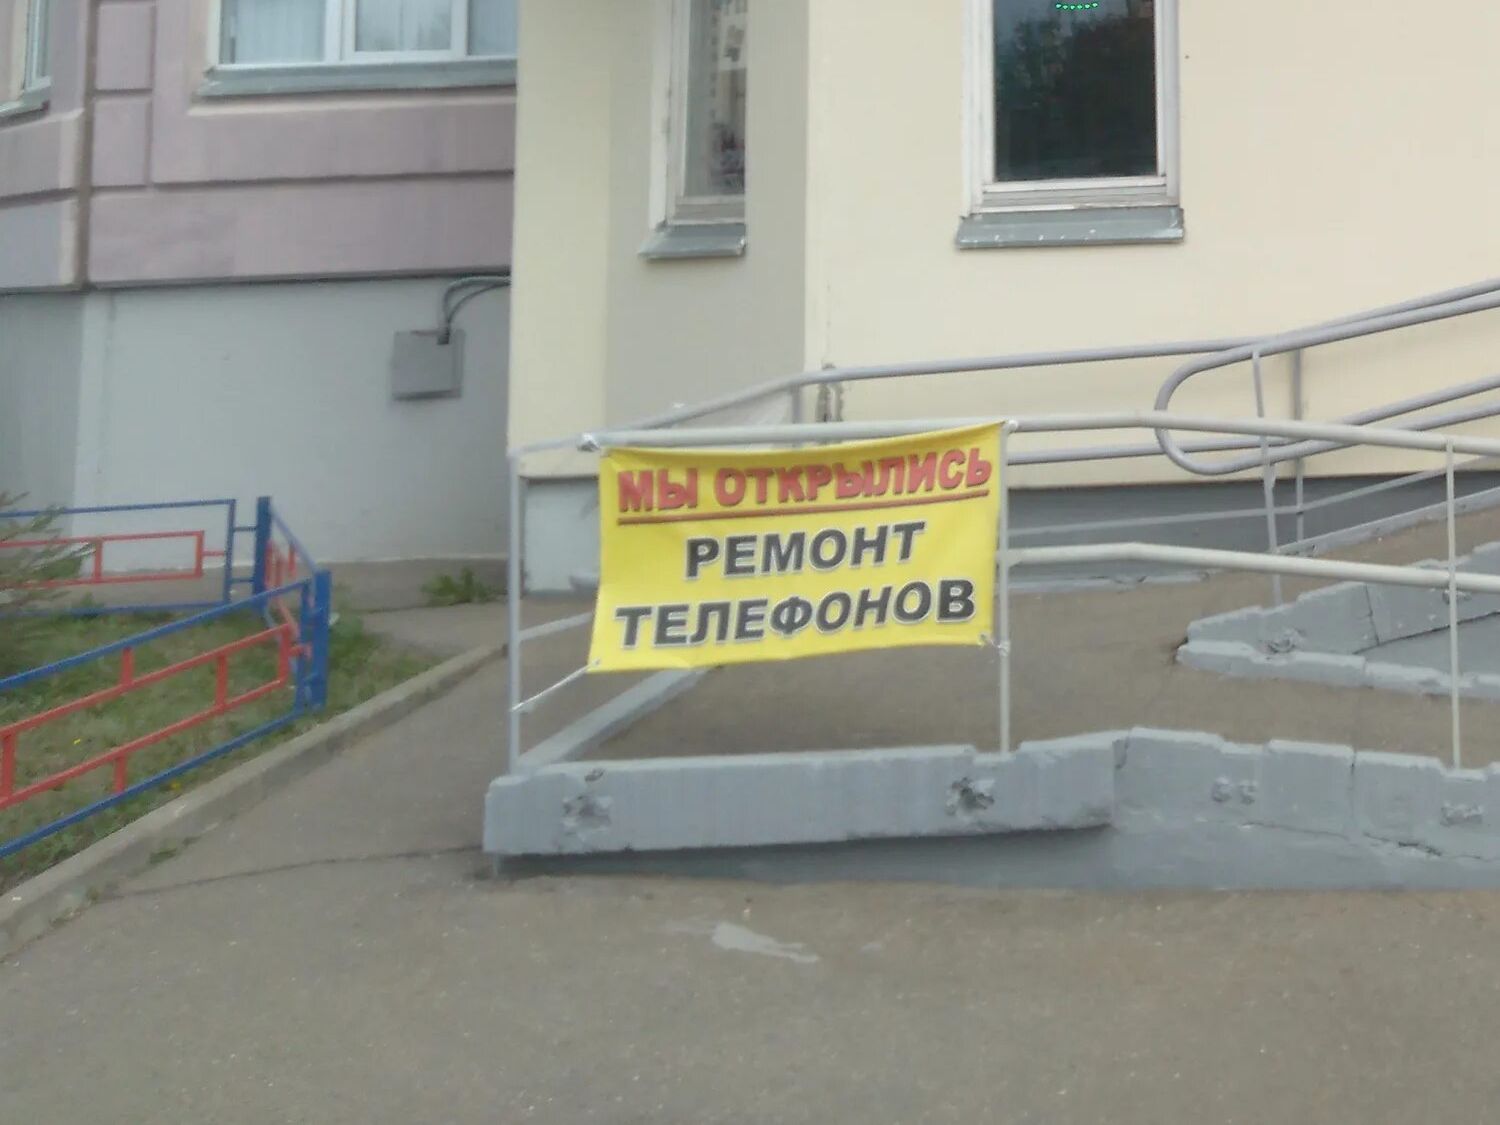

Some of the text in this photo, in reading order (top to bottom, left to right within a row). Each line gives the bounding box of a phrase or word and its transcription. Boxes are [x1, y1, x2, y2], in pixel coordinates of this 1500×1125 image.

[617, 448, 992, 514] МЫ ОТКРЫЛИСЬ
[684, 520, 926, 580] РЕМОНТ
[614, 578, 977, 649] ТЕЛЕФОНОВ
